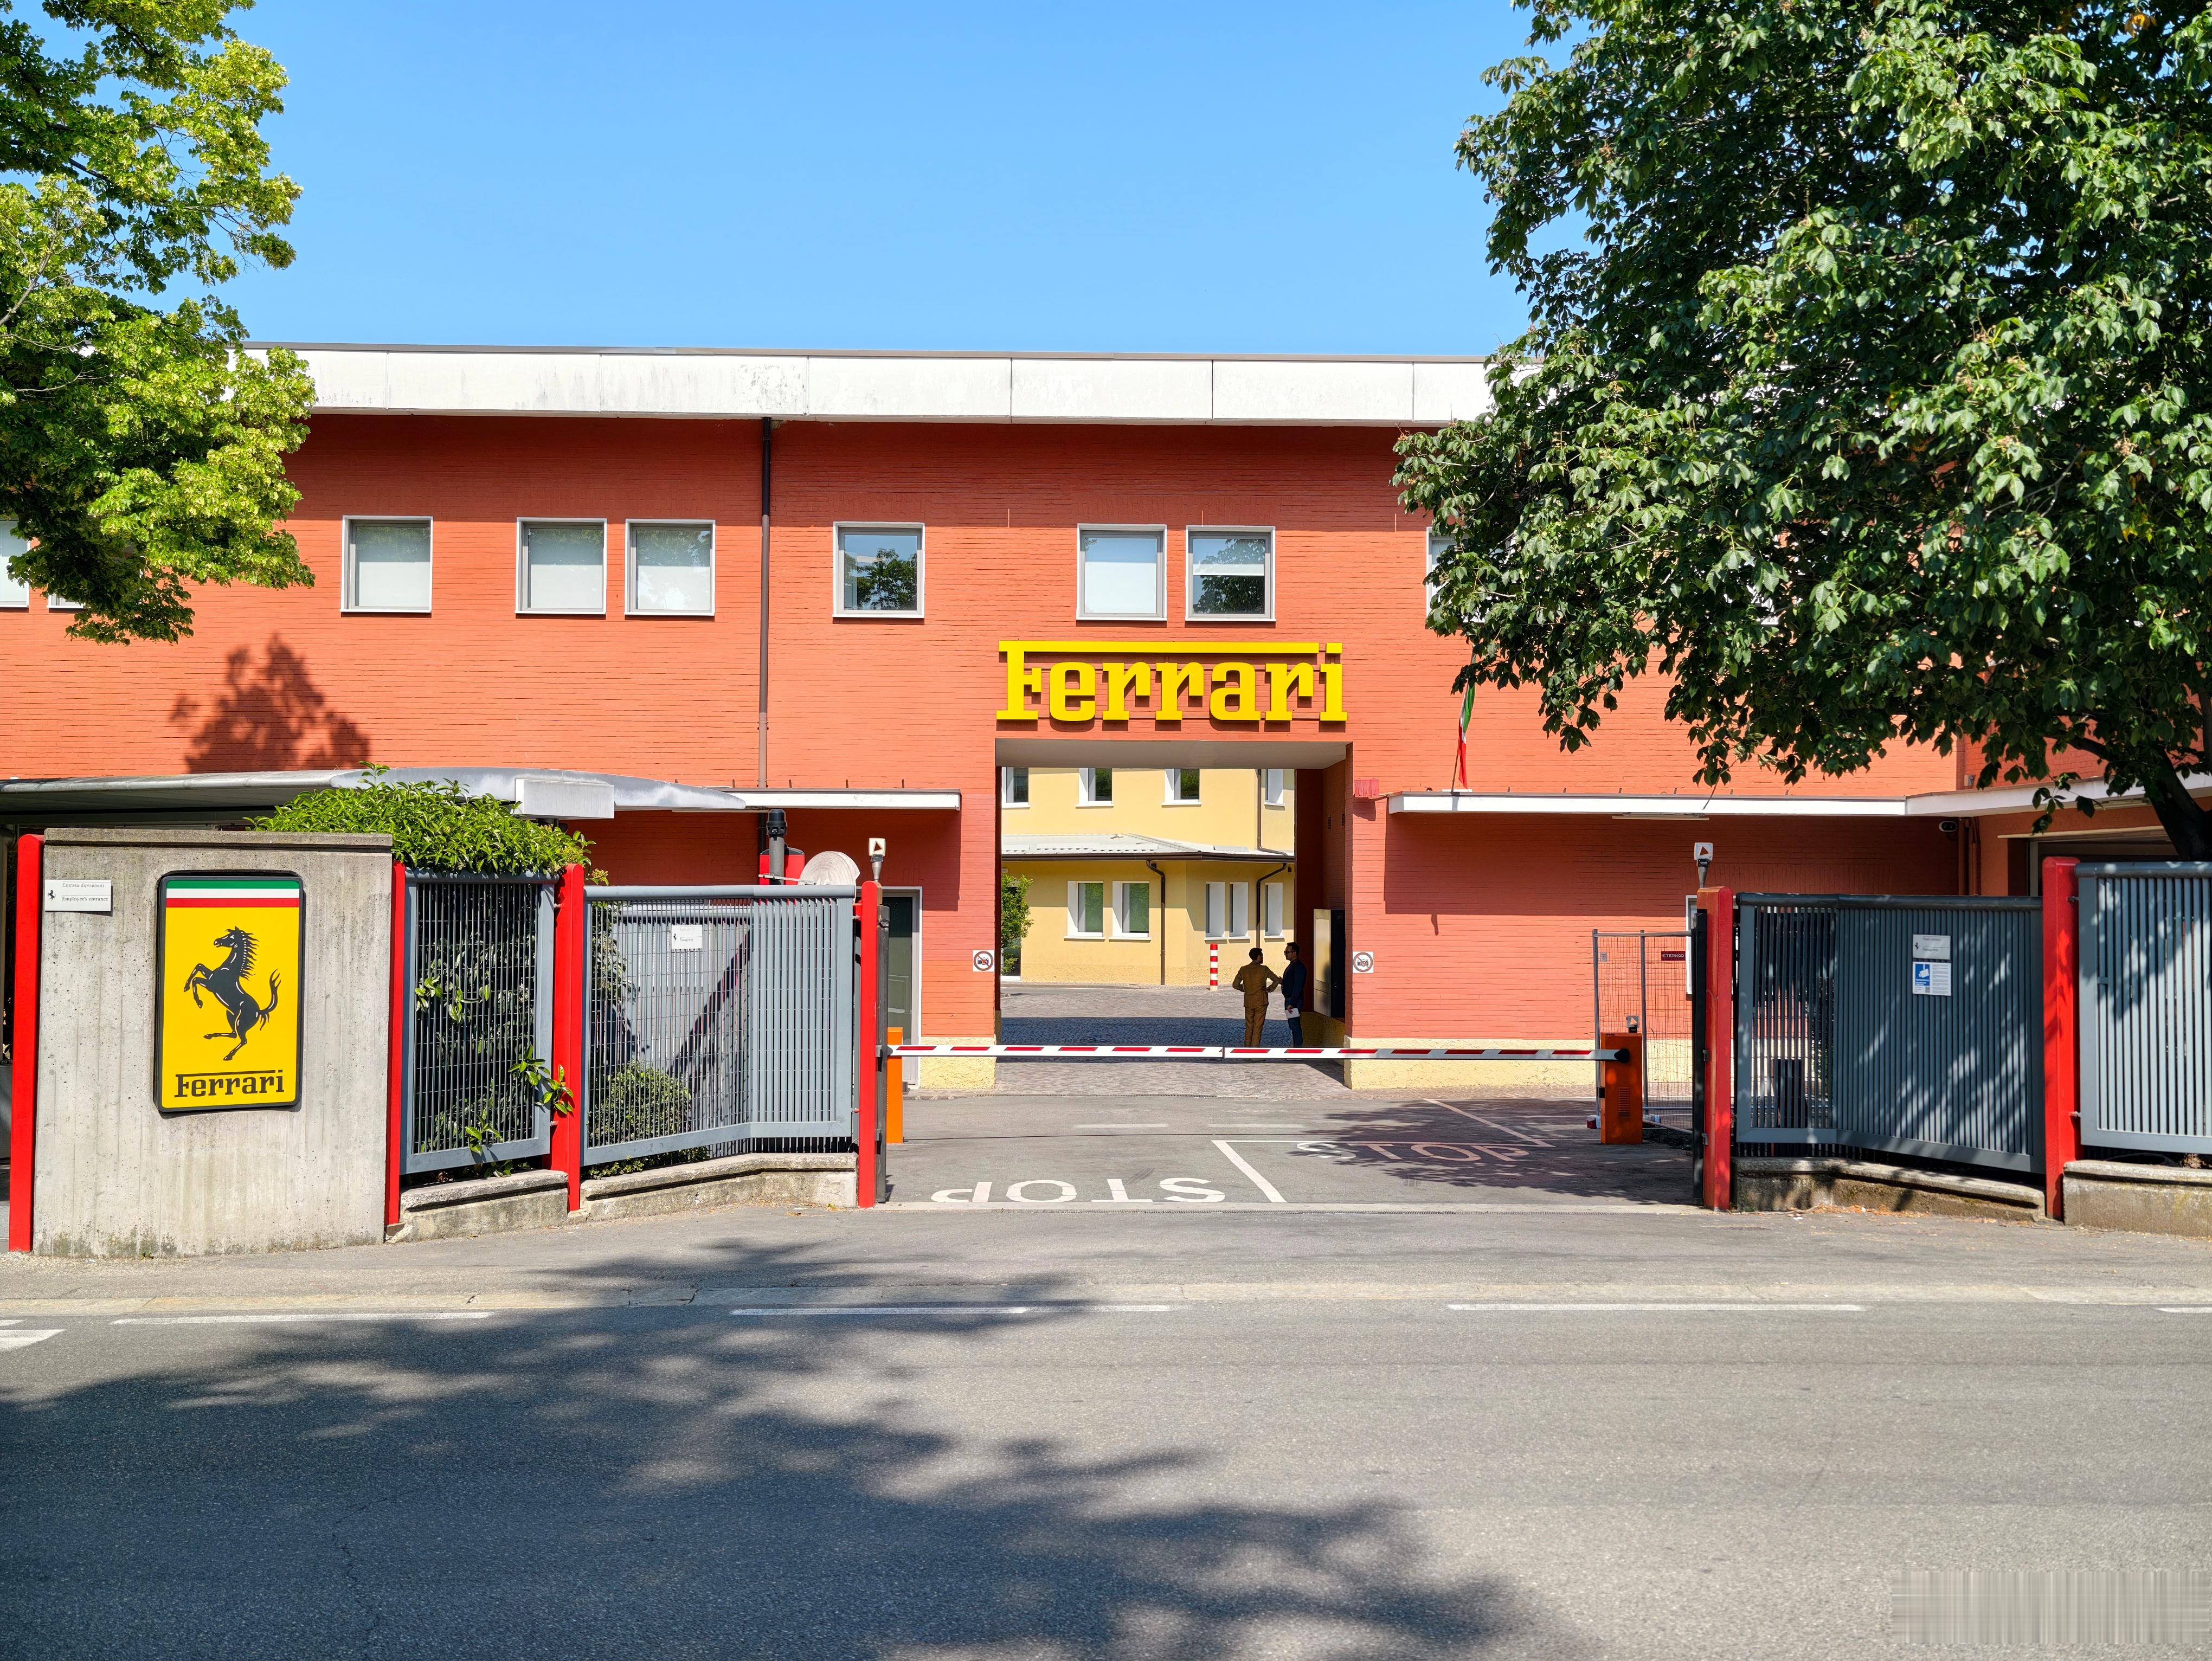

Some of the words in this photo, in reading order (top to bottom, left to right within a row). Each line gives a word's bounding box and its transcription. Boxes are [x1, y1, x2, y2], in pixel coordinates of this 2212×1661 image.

[996, 640, 1348, 722] Ferrari
[174, 1070, 285, 1098] Ferrari
[1296, 1142, 1530, 1162] STOP
[930, 1177, 1226, 1203] STOP
